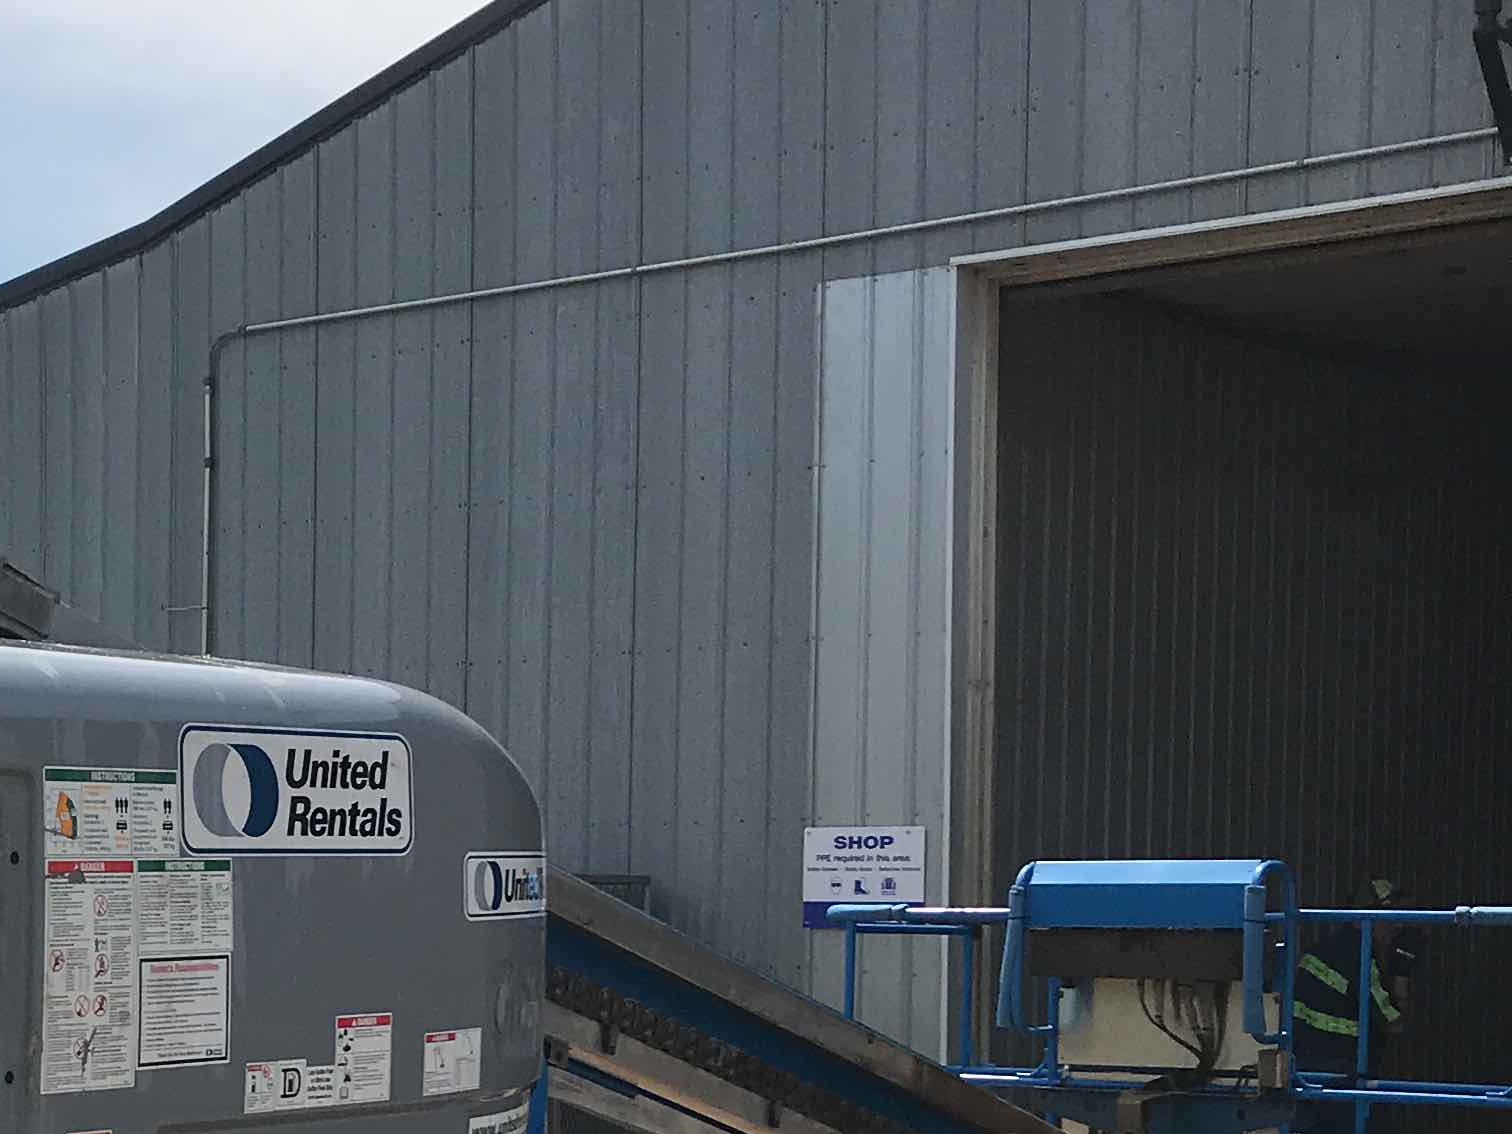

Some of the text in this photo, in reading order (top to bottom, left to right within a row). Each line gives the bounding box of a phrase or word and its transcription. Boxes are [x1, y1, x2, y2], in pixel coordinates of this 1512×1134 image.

[286, 749, 389, 790] United
[287, 796, 402, 837] Rentals
[833, 835, 895, 849] SHOP
